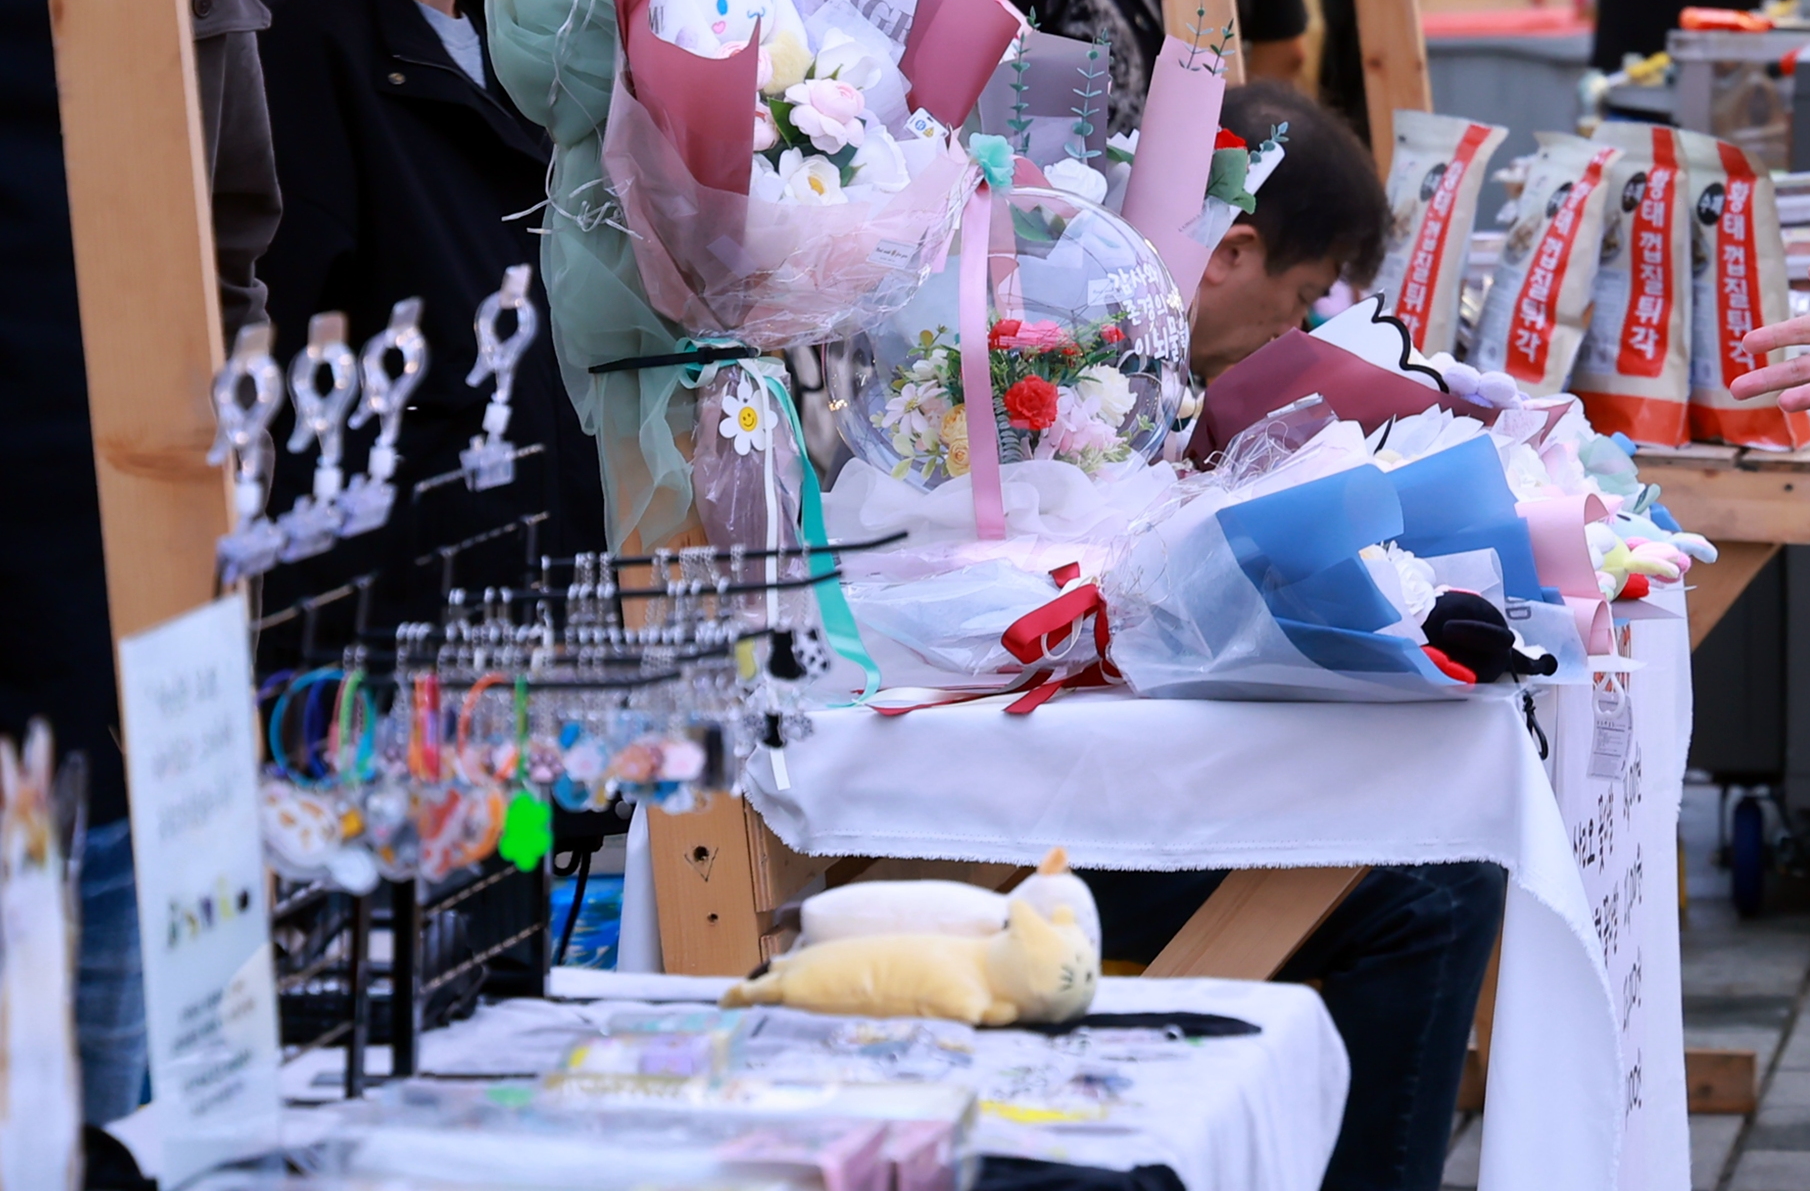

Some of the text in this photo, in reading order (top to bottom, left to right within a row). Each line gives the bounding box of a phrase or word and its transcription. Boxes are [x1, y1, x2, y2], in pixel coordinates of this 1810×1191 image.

[1723, 181, 1750, 241] 황태
[1107, 262, 1159, 296] 감사와
[1515, 182, 1590, 363] 황태 껍질튀각
[1629, 169, 1670, 360] 황태 껍질튀각
[1122, 293, 1168, 326] 존경의
